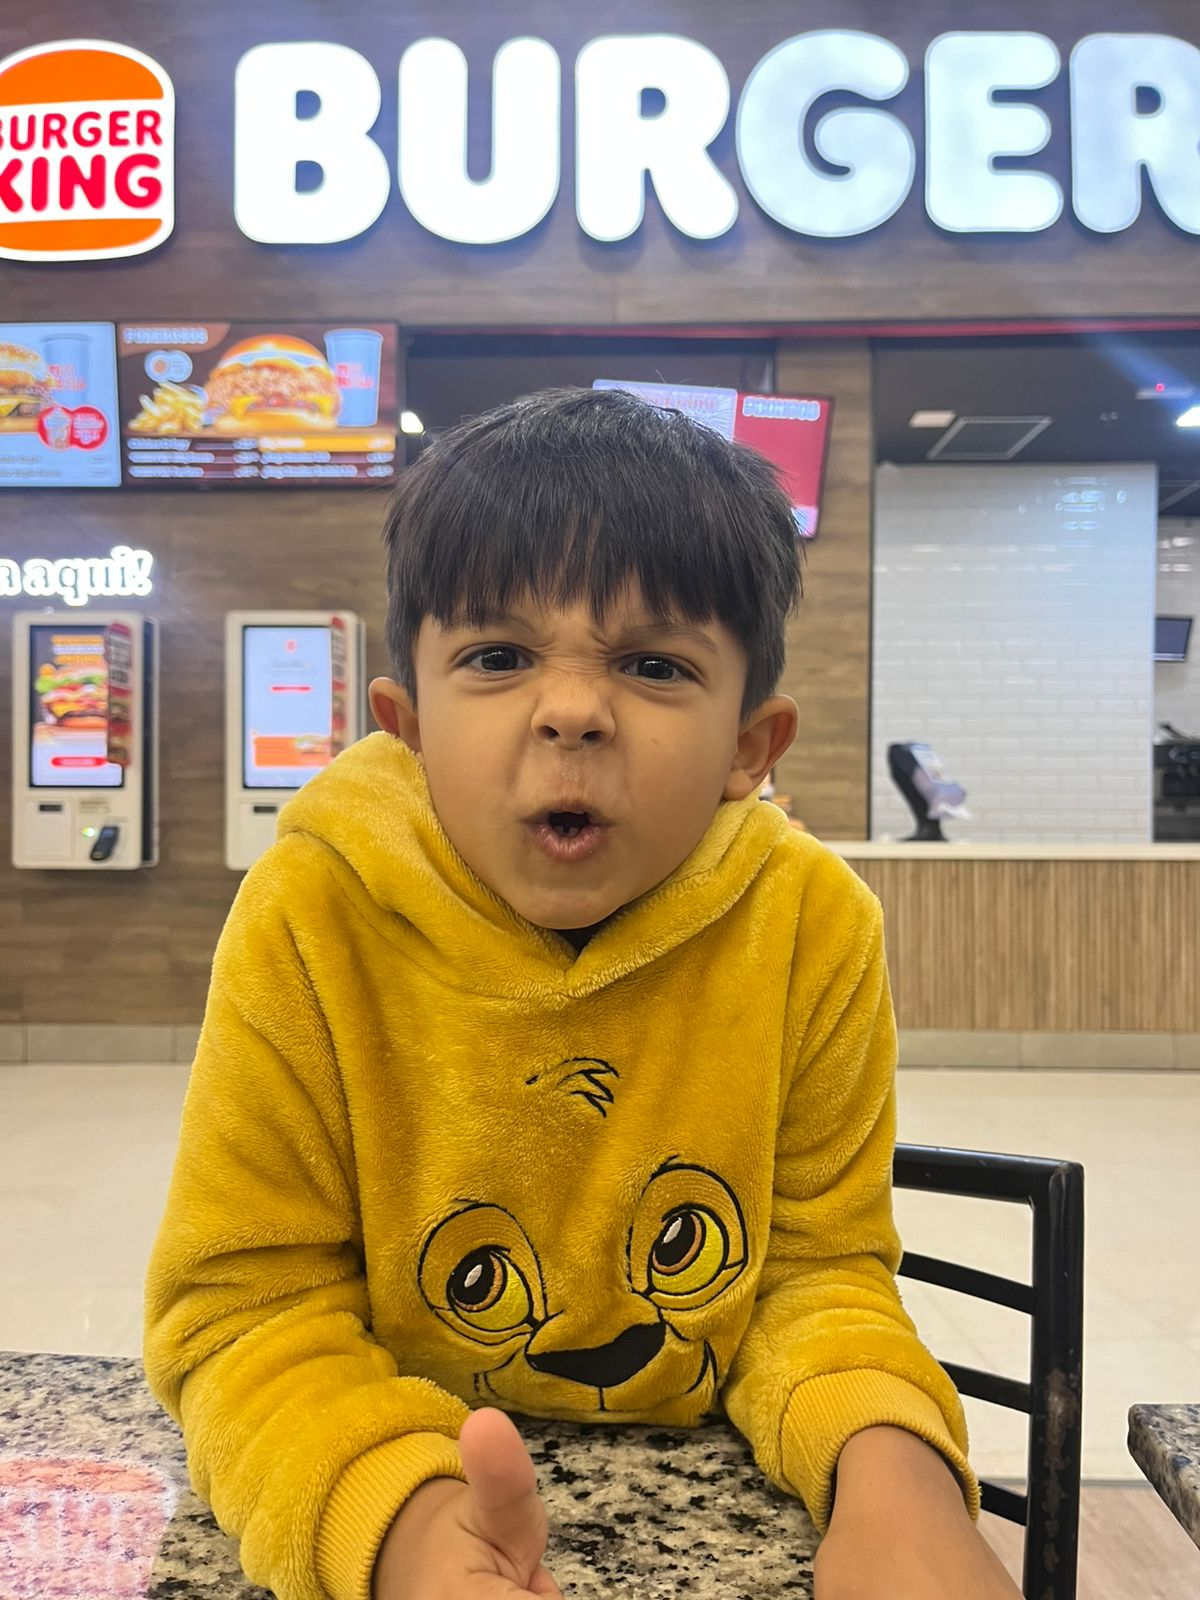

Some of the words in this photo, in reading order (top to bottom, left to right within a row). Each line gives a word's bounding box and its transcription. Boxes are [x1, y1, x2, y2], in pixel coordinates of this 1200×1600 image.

[0, 110, 163, 152] URGER
[234, 30, 1200, 244] BURGER
[24, 547, 152, 604] aqui!
